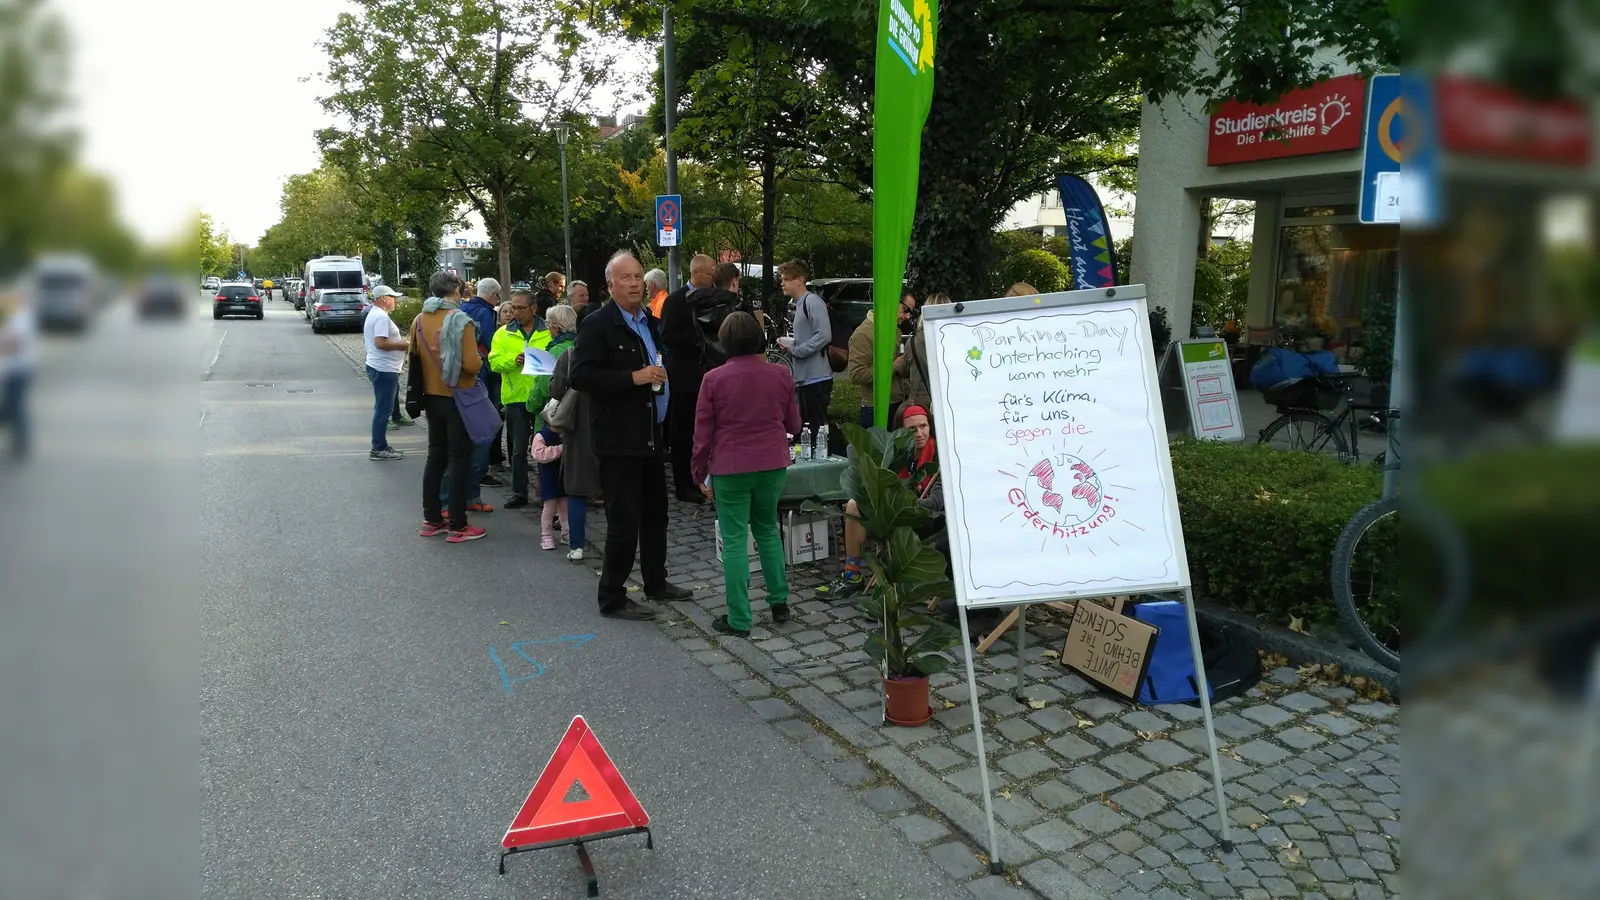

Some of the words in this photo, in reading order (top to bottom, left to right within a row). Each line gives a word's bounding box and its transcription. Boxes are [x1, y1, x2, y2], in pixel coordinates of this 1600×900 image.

[1214, 104, 1317, 135] Studienkreis
[1237, 134, 1255, 145] Die
[1259, 125, 1316, 143] Nhilfe
[1066, 208, 1089, 252] Heart
[972, 320, 1129, 356] Parking-Day
[989, 345, 1101, 369] Unterhaching
[1053, 365, 1099, 379] mehr
[1043, 389, 1096, 404] Klima,
[1000, 412, 1028, 424] für
[1041, 409, 1075, 423] uns,
[1006, 427, 1052, 446] gegen
[1061, 422, 1093, 436] die
[1007, 488, 1119, 539] Erderhitzung!
[1075, 605, 1128, 642] SCIENCE
[1080, 630, 1097, 649] THE
